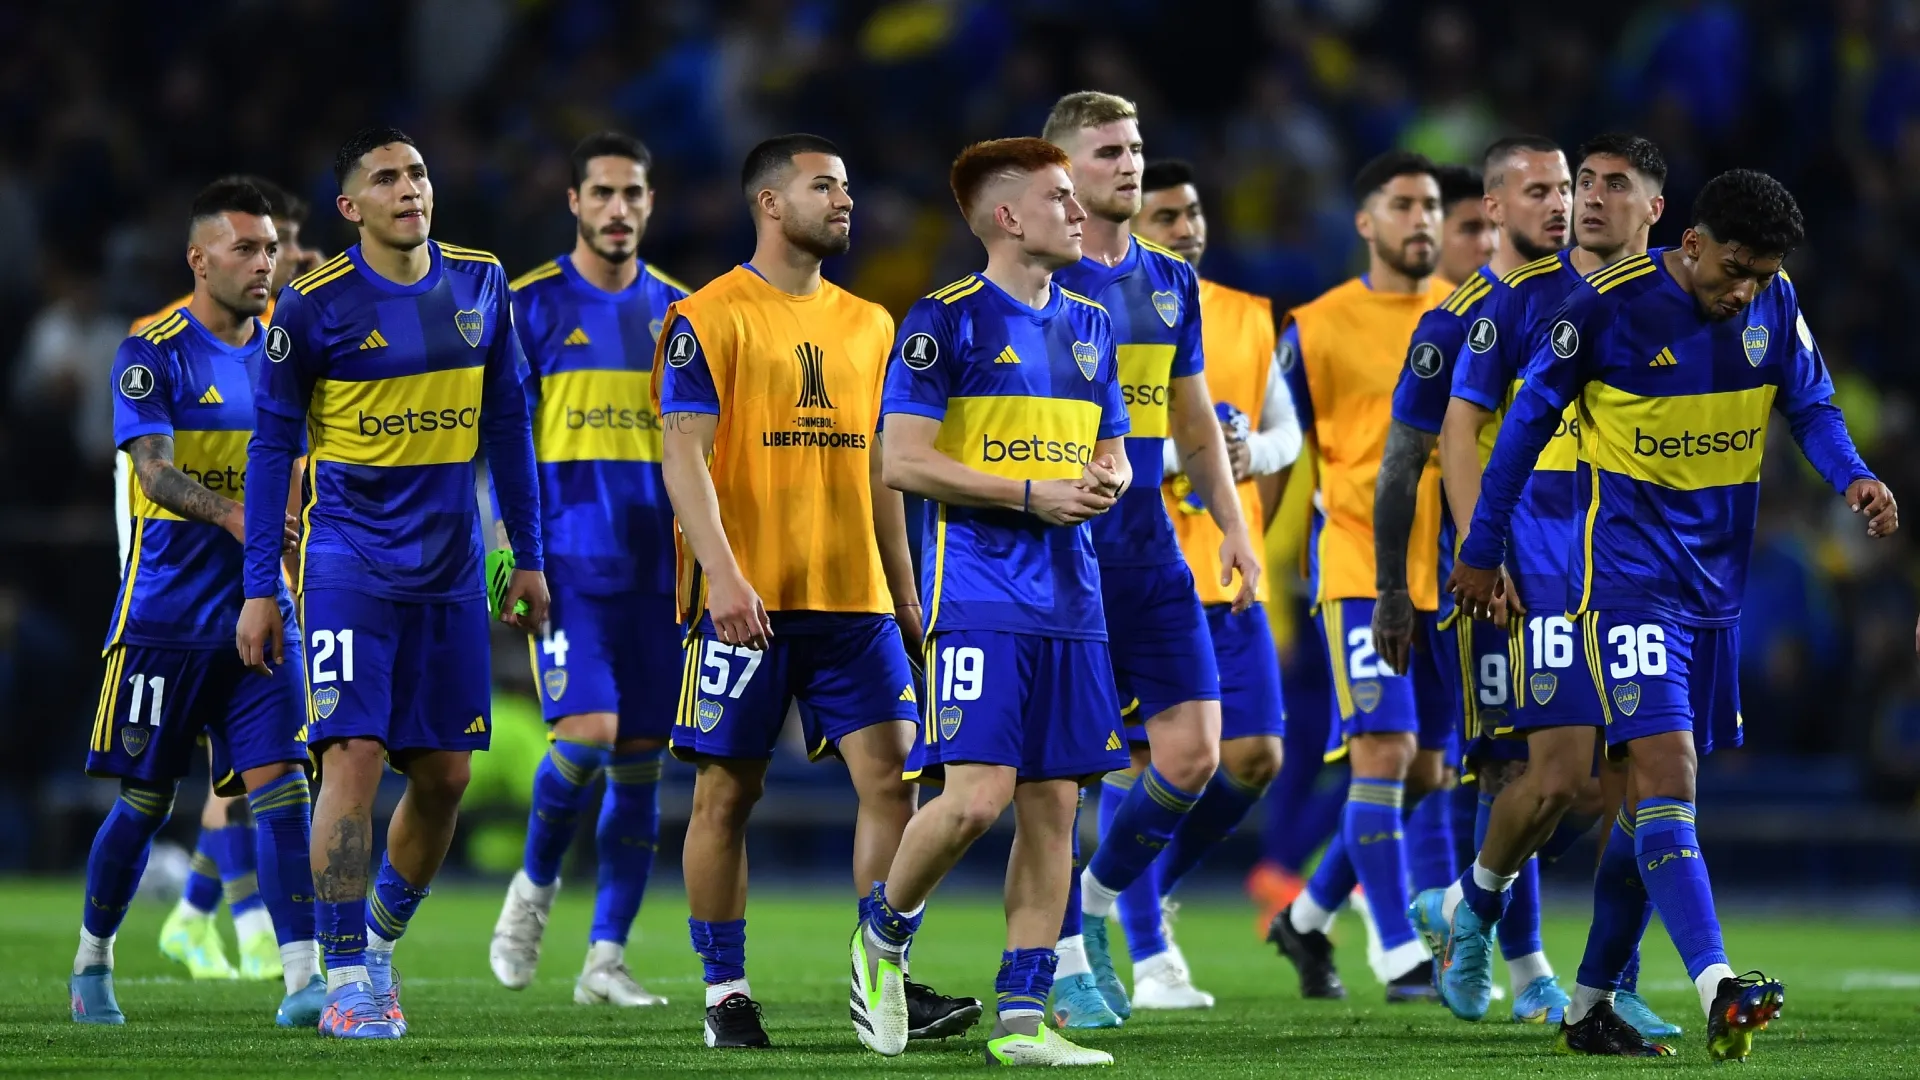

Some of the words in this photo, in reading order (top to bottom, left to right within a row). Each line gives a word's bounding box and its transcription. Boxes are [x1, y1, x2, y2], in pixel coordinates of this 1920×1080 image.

[460, 321, 480, 330] CABJ
[1746, 340, 1765, 349] CABJ
[1077, 354, 1095, 364] CABJ
[358, 407, 477, 437] betsso
[762, 431, 866, 449] LIBERTADORES
[983, 434, 1092, 467] betsso
[1529, 616, 1573, 669] 16
[1608, 624, 1667, 679] 36
[312, 629, 354, 684] 21
[701, 640, 764, 698] 57
[941, 647, 985, 701] 19
[1480, 654, 1507, 706] 9
[1534, 683, 1552, 691] CABJ
[1618, 693, 1637, 703] CABJ
[128, 673, 165, 727] 11
[316, 695, 335, 705] CABJ
[700, 709, 718, 719] CABJ
[942, 717, 958, 725] CABJ
